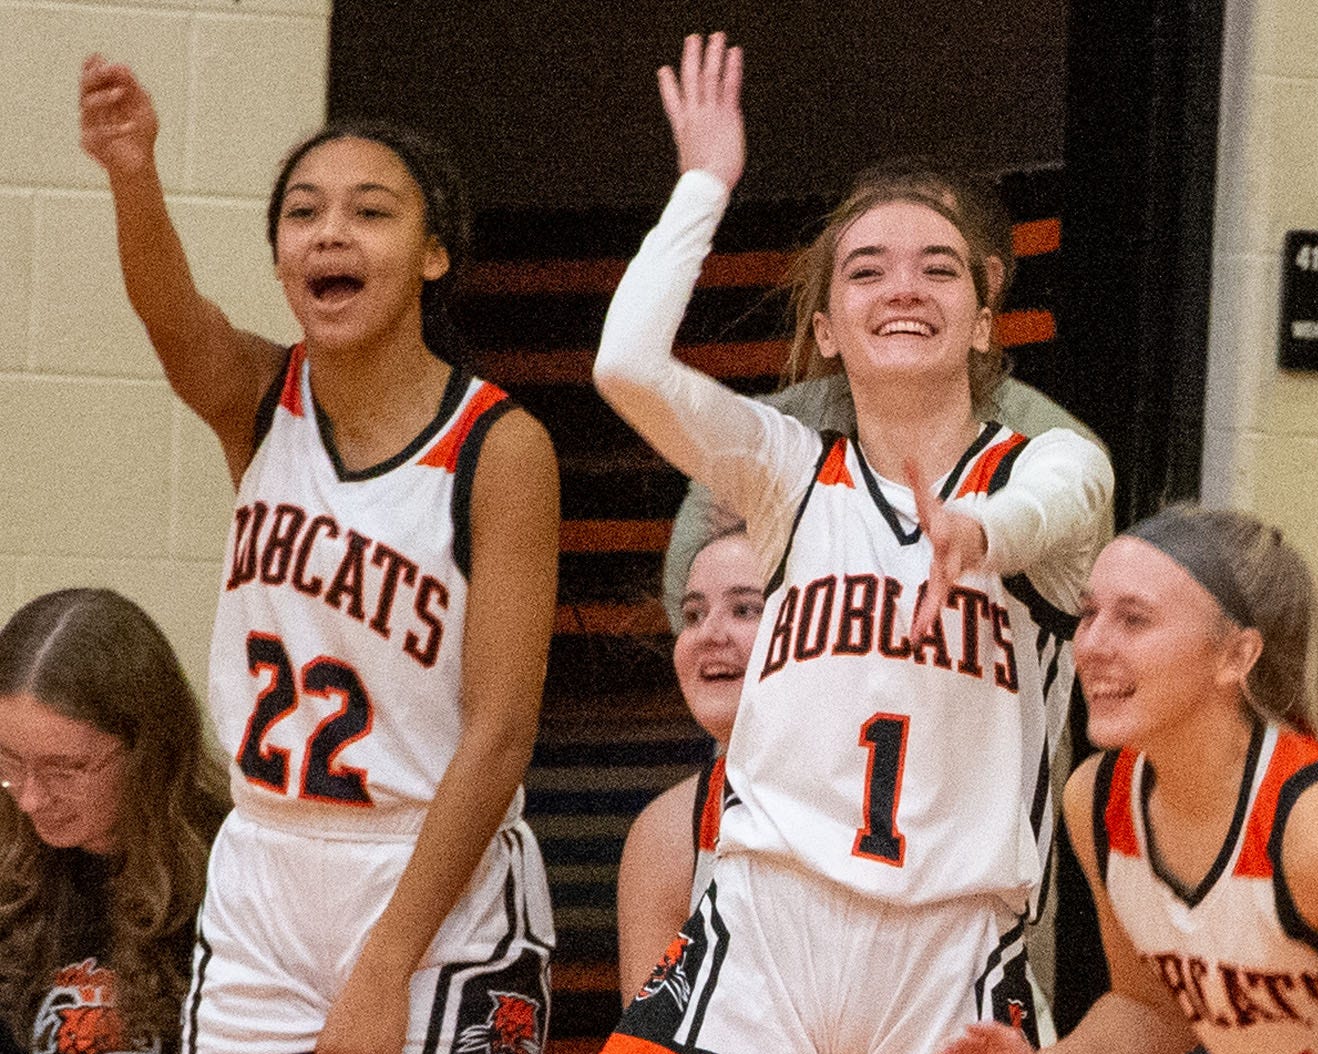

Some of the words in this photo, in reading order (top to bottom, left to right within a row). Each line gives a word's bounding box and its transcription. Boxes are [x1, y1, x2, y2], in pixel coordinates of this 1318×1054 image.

[758, 573, 1019, 694] BOBCATS
[235, 630, 376, 808] 22
[851, 711, 911, 868] 1
